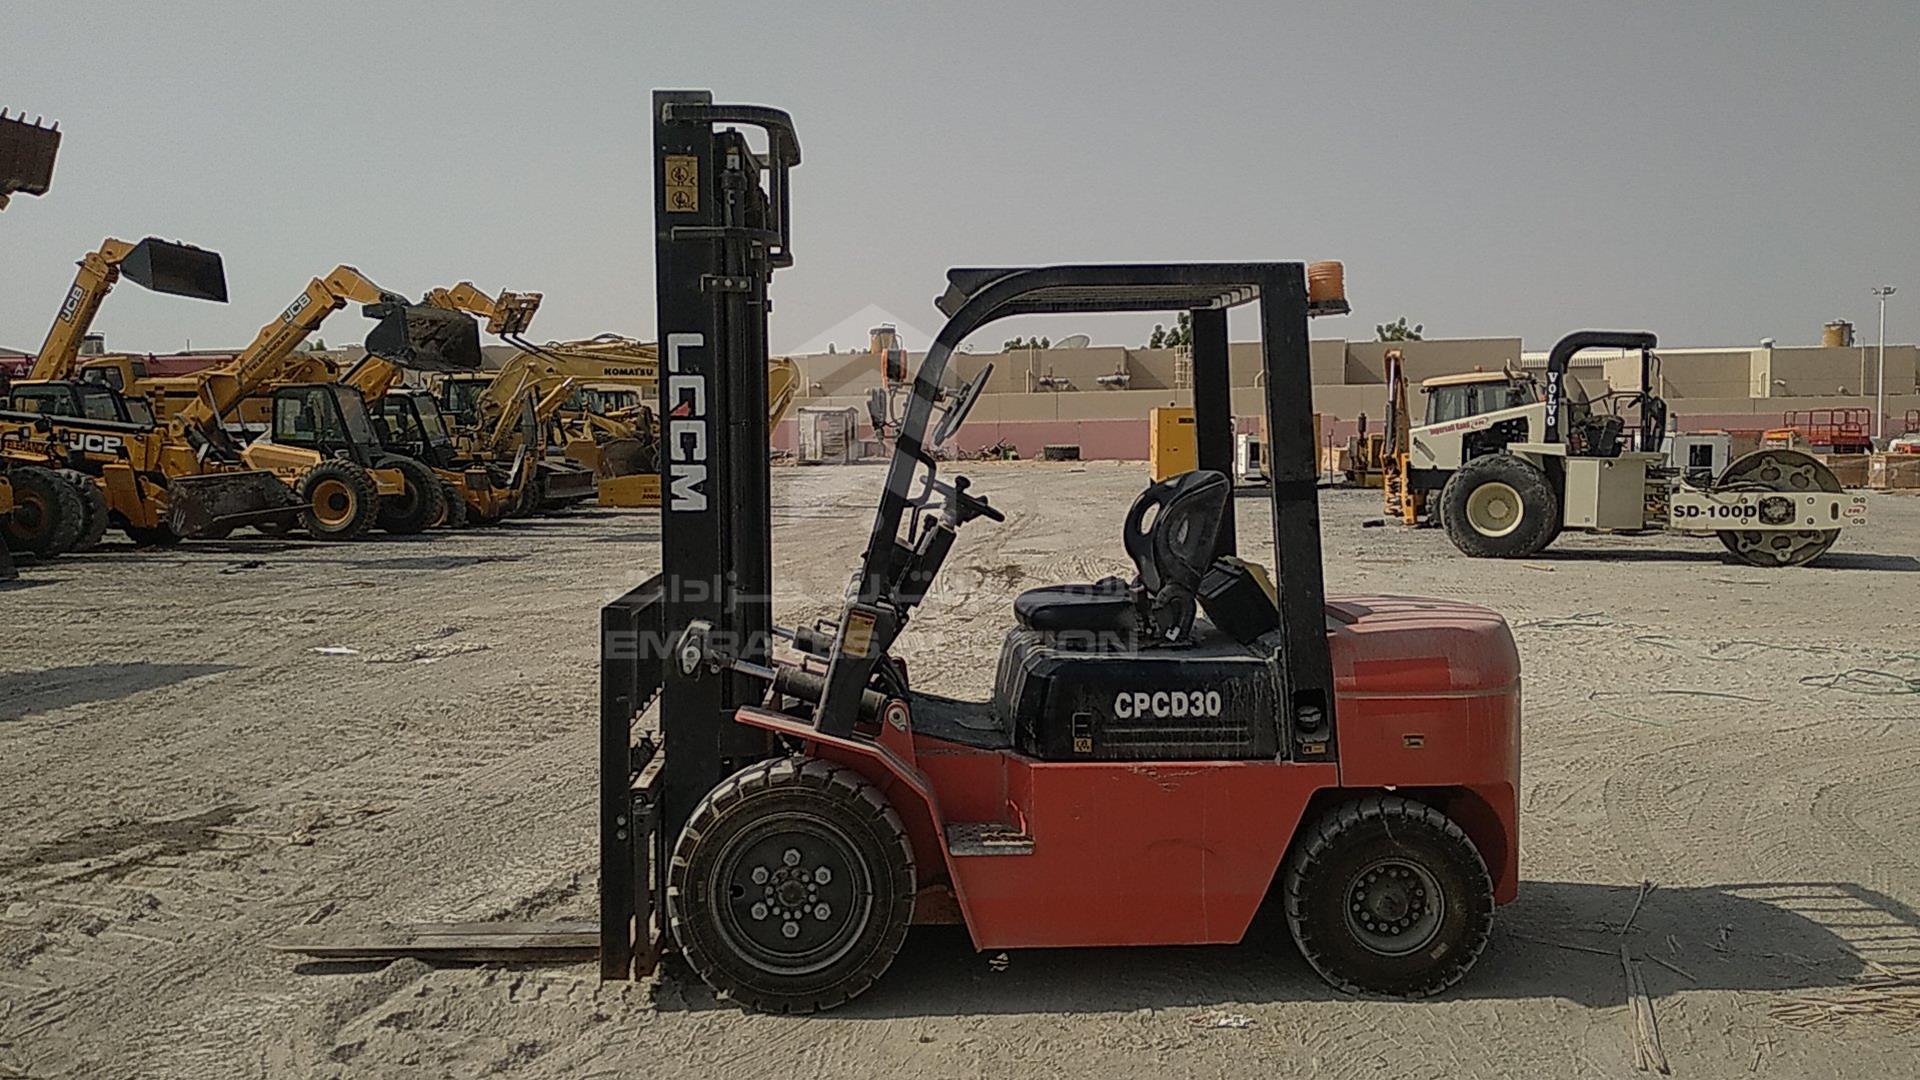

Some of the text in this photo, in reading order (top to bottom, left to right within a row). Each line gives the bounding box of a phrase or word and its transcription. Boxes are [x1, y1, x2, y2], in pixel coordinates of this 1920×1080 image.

[60, 286, 84, 321] JCB
[282, 293, 311, 323] JCB
[603, 367, 653, 376] KOMATSU
[1546, 371, 1559, 427] VOLVO
[69, 432, 122, 454] JCB
[1673, 504, 1757, 518] SD-100D
[1114, 690, 1221, 719] CPCD30
